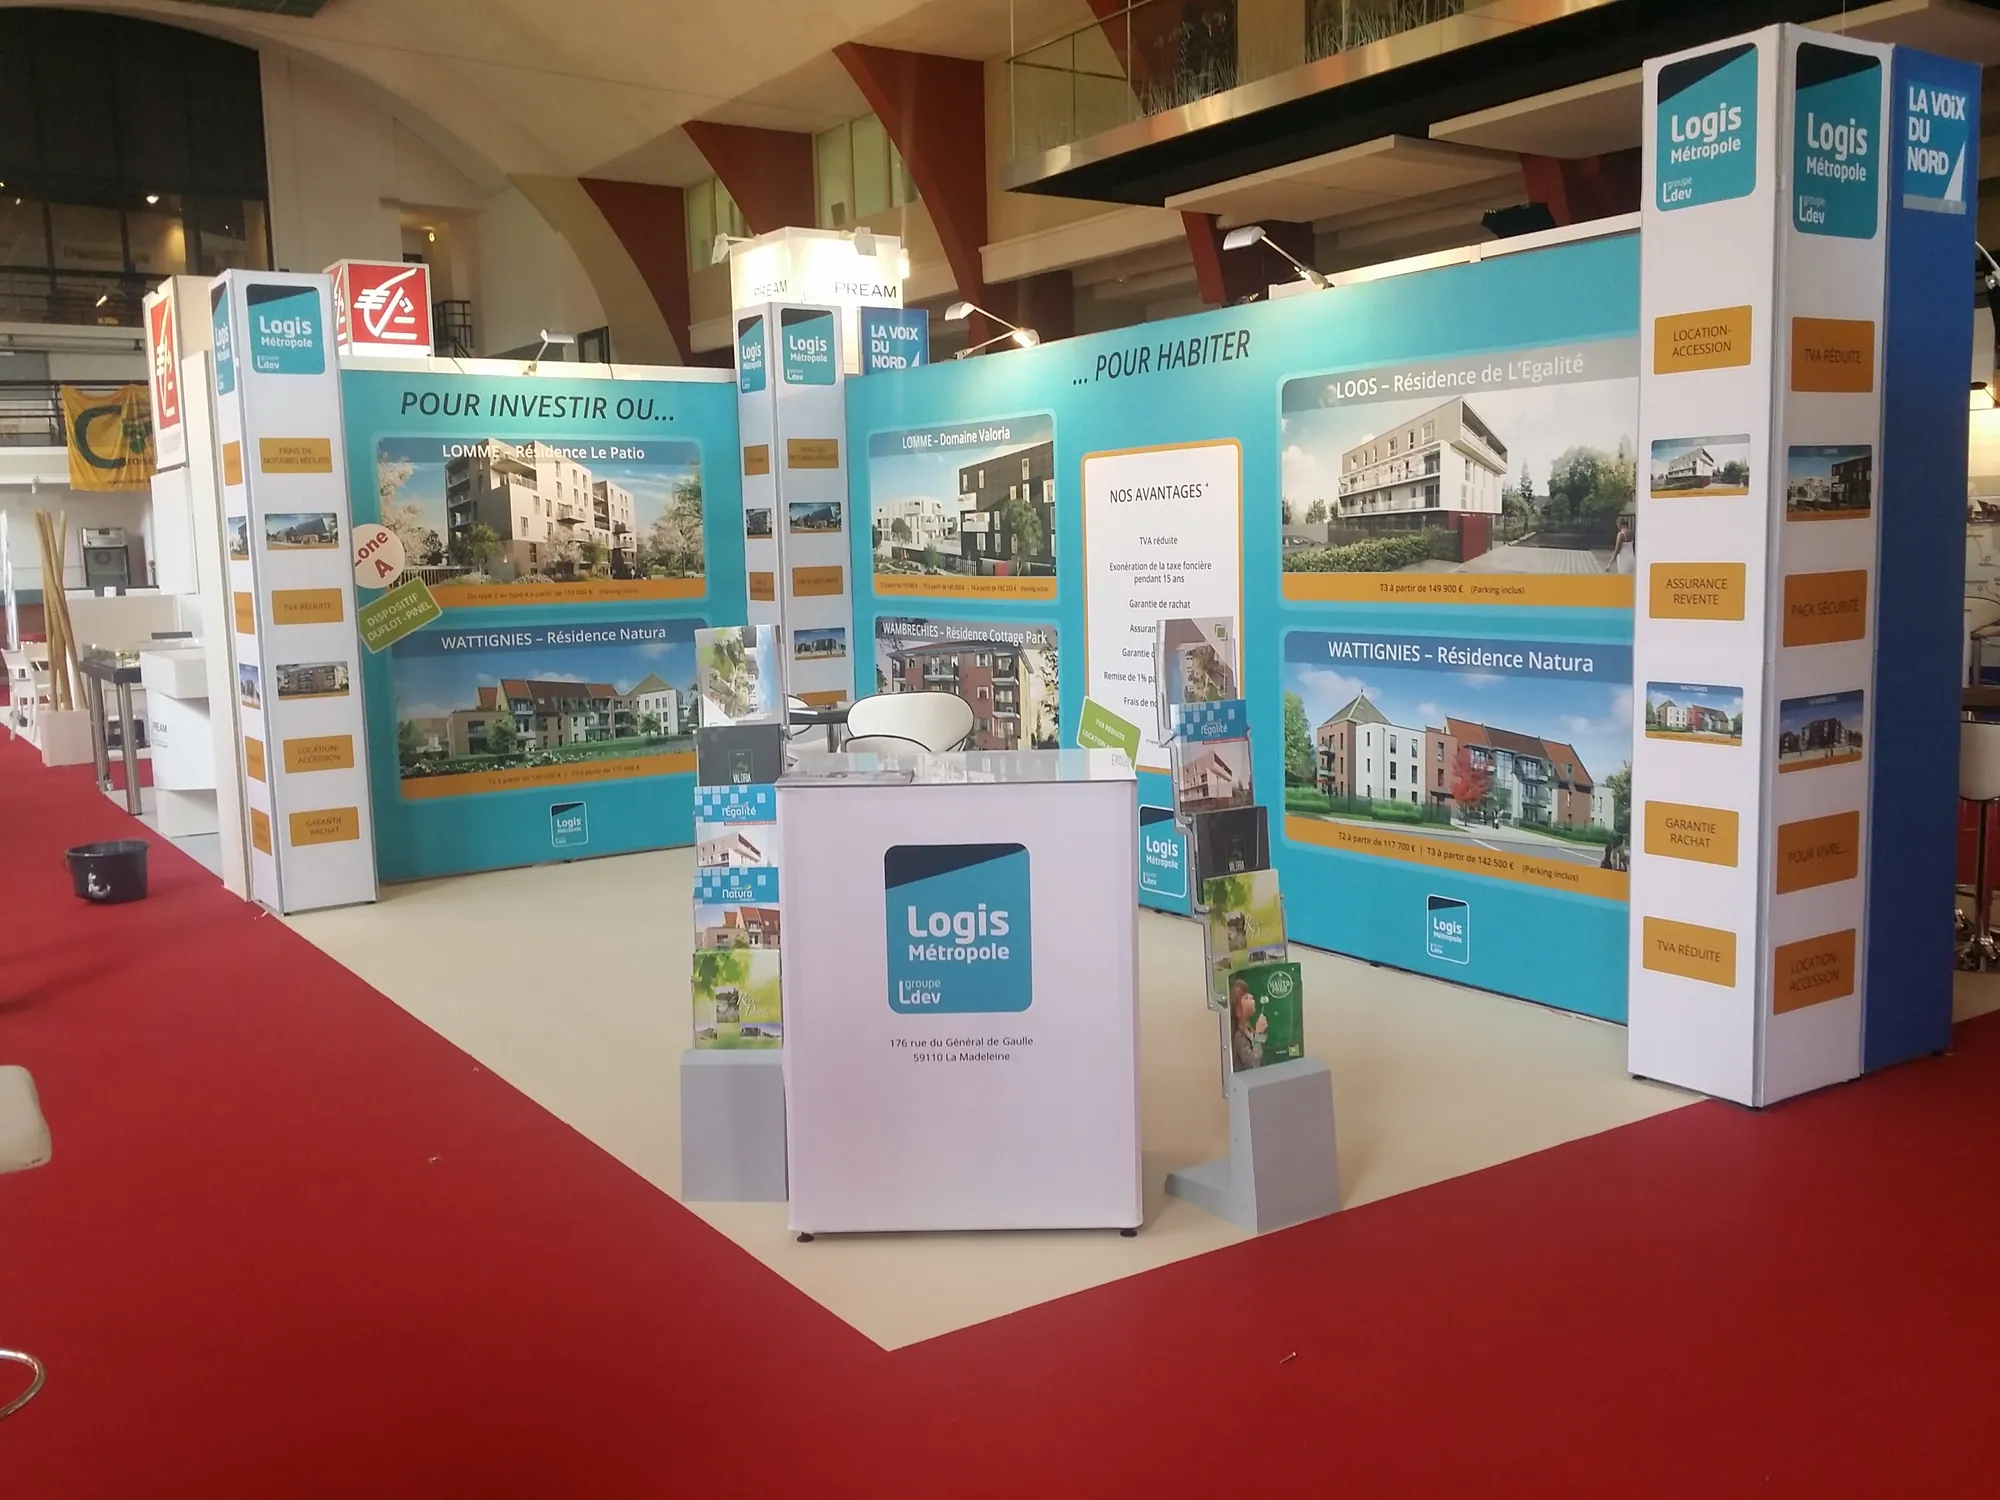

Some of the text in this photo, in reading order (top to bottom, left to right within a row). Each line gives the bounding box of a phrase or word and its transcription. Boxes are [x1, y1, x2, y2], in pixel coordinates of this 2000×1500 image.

[1909, 86, 1928, 113] LA
[1670, 103, 1742, 143] Logis
[1909, 117, 1930, 143] DU
[1807, 112, 1867, 162] Logis
[1670, 137, 1741, 164] Métropole
[1806, 156, 1866, 183] Métropole
[1907, 147, 1949, 176] NORD
[1663, 182, 1692, 203] Ldev
[1799, 195, 1825, 225] Ldev
[834, 282, 897, 298] PREAM
[259, 316, 313, 338] Logis
[871, 325, 887, 338] LA
[1673, 325, 1731, 342] LOCATION-
[261, 337, 313, 349] Métropole
[742, 342, 761, 362] Logis
[789, 335, 827, 354] Logis
[872, 340, 889, 353] DU
[1672, 341, 1732, 357] ACCESSION
[790, 353, 827, 363] Métropole
[872, 355, 906, 369] NORD
[1096, 347, 1150, 381] POUR
[1157, 330, 1250, 371] HABITER
[1804, 349, 1821, 363] TVA
[1336, 377, 1378, 399] LOOS
[1394, 368, 1476, 393] Résidence
[1481, 365, 1503, 382] de
[400, 391, 674, 421] POUR INVESTIR OU...
[902, 426, 1010, 449] LOMME Domaine Valoria
[442, 444, 644, 460] LOMME Résidence Le Patio
[1110, 484, 1202, 503] NOS AVANTAGES
[1140, 536, 1178, 545] TVA réduite
[375, 558, 394, 578] A
[1110, 562, 1147, 571] Exonération
[1159, 562, 1165, 570] la
[1183, 561, 1211, 570] foncière
[1134, 575, 1161, 585] pendant
[1164, 575, 1171, 583] 15
[1380, 583, 1524, 595] T3 à partir de 149 900 € (Parking inclus)
[1666, 578, 1727, 589] ASSURANCE
[1129, 599, 1191, 609] Garantie de rachat
[1674, 594, 1718, 605] REVENTE
[1792, 596, 1859, 617] PACK SÉCURITÉ
[367, 592, 419, 627] DISPOSITIF
[441, 627, 666, 649] WATTIGNIES Résidence Natura
[882, 622, 1047, 646] WAMBRECHIES Résidence Cottage Park
[1122, 649, 1150, 657] Garantie
[1328, 641, 1593, 673] WATTIGNIES Résidence Natura
[1104, 672, 1147, 683] Remise de 1%
[1124, 697, 1148, 707] Frais de
[556, 817, 581, 828] Logis
[1666, 818, 1716, 834] GARANTIE
[1146, 836, 1178, 858] Logis
[1670, 833, 1711, 848] RACHAT
[1146, 855, 1178, 869] Métropole
[1339, 831, 1579, 882] T2 à partir de 117 700 € T3 à partir de 142 500 € (Parking inclus)
[1788, 851, 1814, 864] POUR
[907, 903, 1010, 945] Logis
[1433, 917, 1463, 936] Logis
[908, 943, 1010, 964] Métropole
[1657, 940, 1721, 962] TVA RÉDUITE
[905, 979, 941, 990] groupe
[1789, 970, 1840, 992] ACCESSION
[899, 980, 941, 1004] Ldev
[890, 1037, 1034, 1048] 176 rue du Général de Gaulle
[913, 1053, 1010, 1063] 59110 La Madeleine
